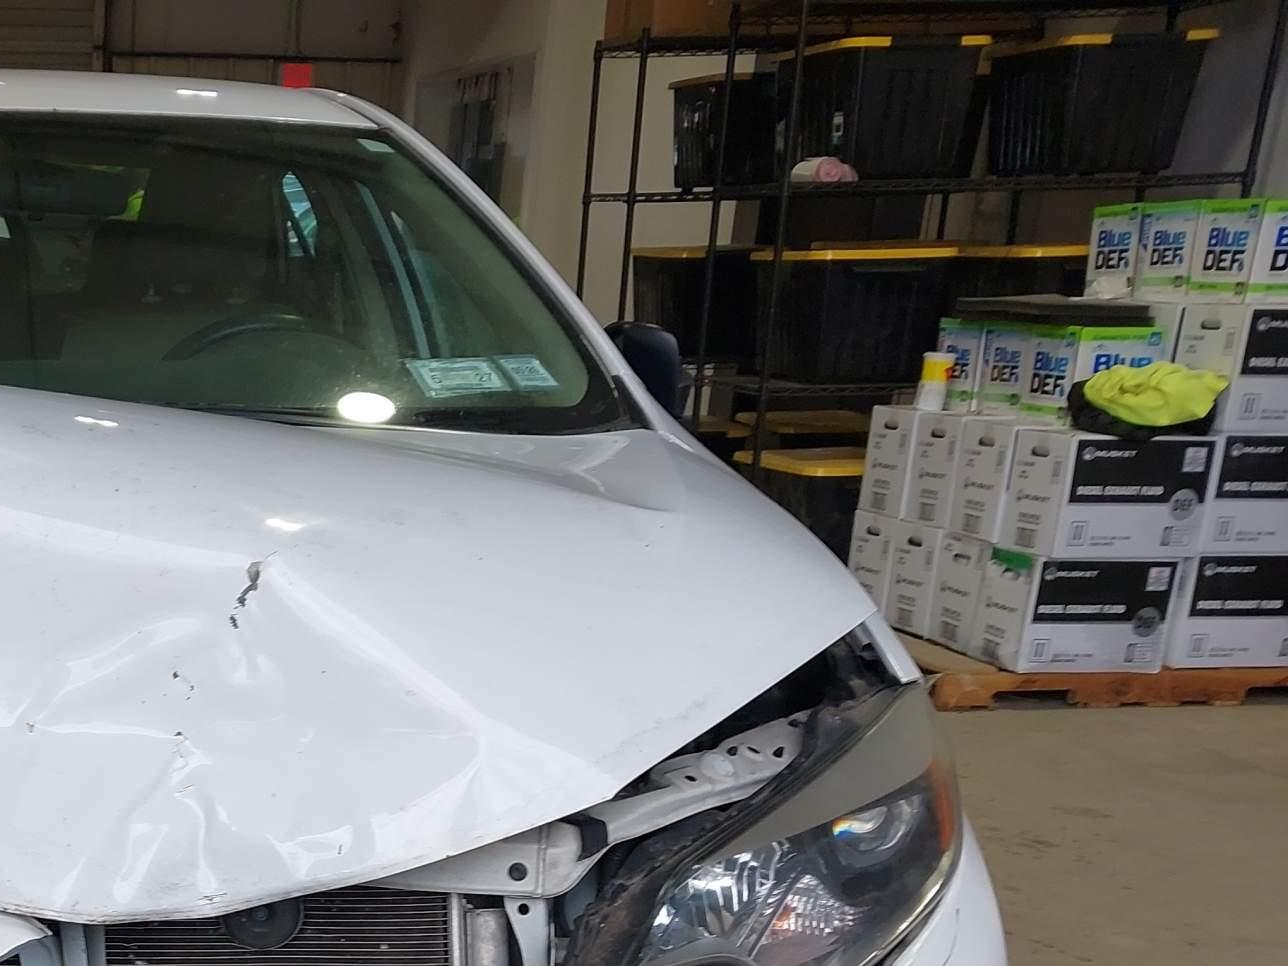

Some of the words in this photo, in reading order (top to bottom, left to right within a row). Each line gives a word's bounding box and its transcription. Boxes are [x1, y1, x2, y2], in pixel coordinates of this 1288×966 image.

[1097, 229, 1132, 248] Blue
[1152, 230, 1186, 246] Blue
[1207, 227, 1250, 247] Blue
[1095, 248, 1129, 270] DEF
[1150, 247, 1184, 266] DEF
[1203, 249, 1247, 272] DEF
[993, 347, 1022, 364] Blue
[1033, 351, 1070, 373] Blue
[990, 364, 1019, 383] DEF
[1030, 372, 1065, 396] DEF
